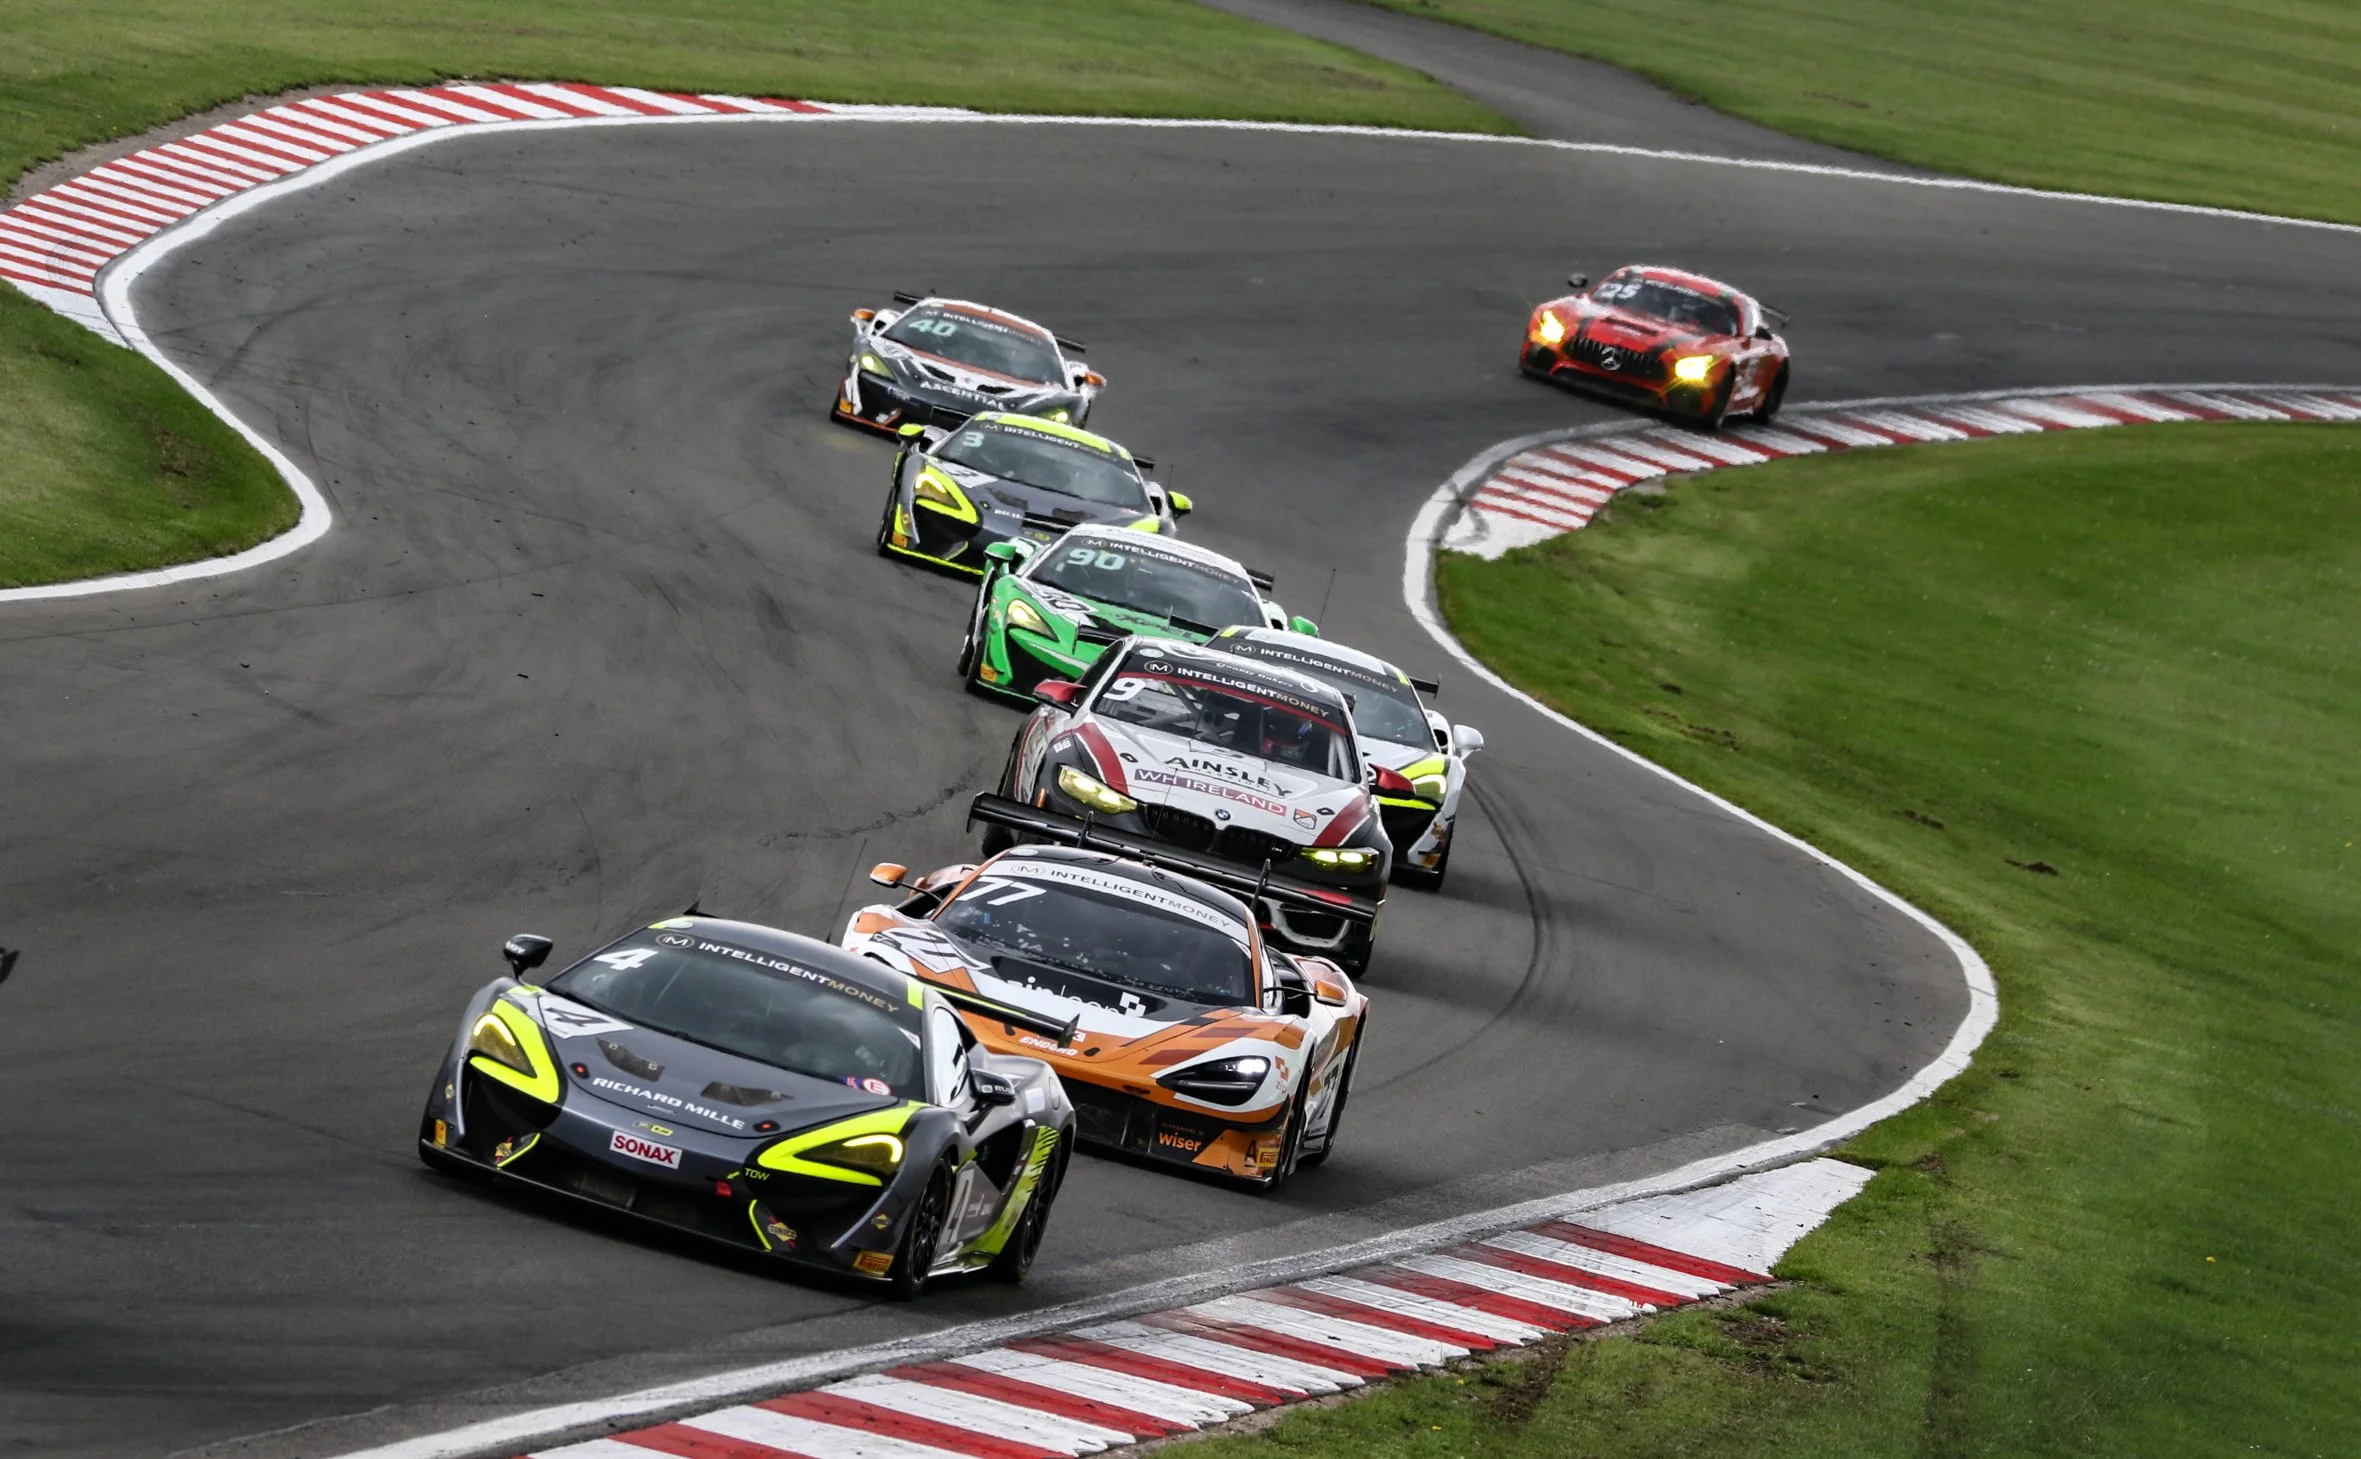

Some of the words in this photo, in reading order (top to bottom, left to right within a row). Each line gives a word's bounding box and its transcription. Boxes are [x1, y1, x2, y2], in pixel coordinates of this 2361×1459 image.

[1599, 280, 1643, 301] 25
[907, 319, 957, 337] 40
[962, 431, 985, 448] 3
[1066, 548, 1126, 571] 90
[1260, 648, 1399, 694] INTELLIGENTMONEY
[1103, 677, 1146, 701] 9
[1177, 666, 1330, 718] INTELLIGENTMONEY
[1138, 769, 1178, 785] WH
[1186, 778, 1285, 814] IRELAND
[1165, 756, 1293, 798] AINSLEY
[955, 876, 1048, 906] 77
[1050, 869, 1232, 928] INTELLIGENTMONEY
[593, 948, 658, 971] 4
[698, 941, 900, 1013] INTELLIGENTMONEY
[592, 1077, 683, 1108] RICHARD
[684, 1102, 746, 1131] MILLE
[613, 1134, 676, 1165] SONAX
[1158, 1131, 1202, 1153] wiser
[743, 1167, 771, 1181] TOW
